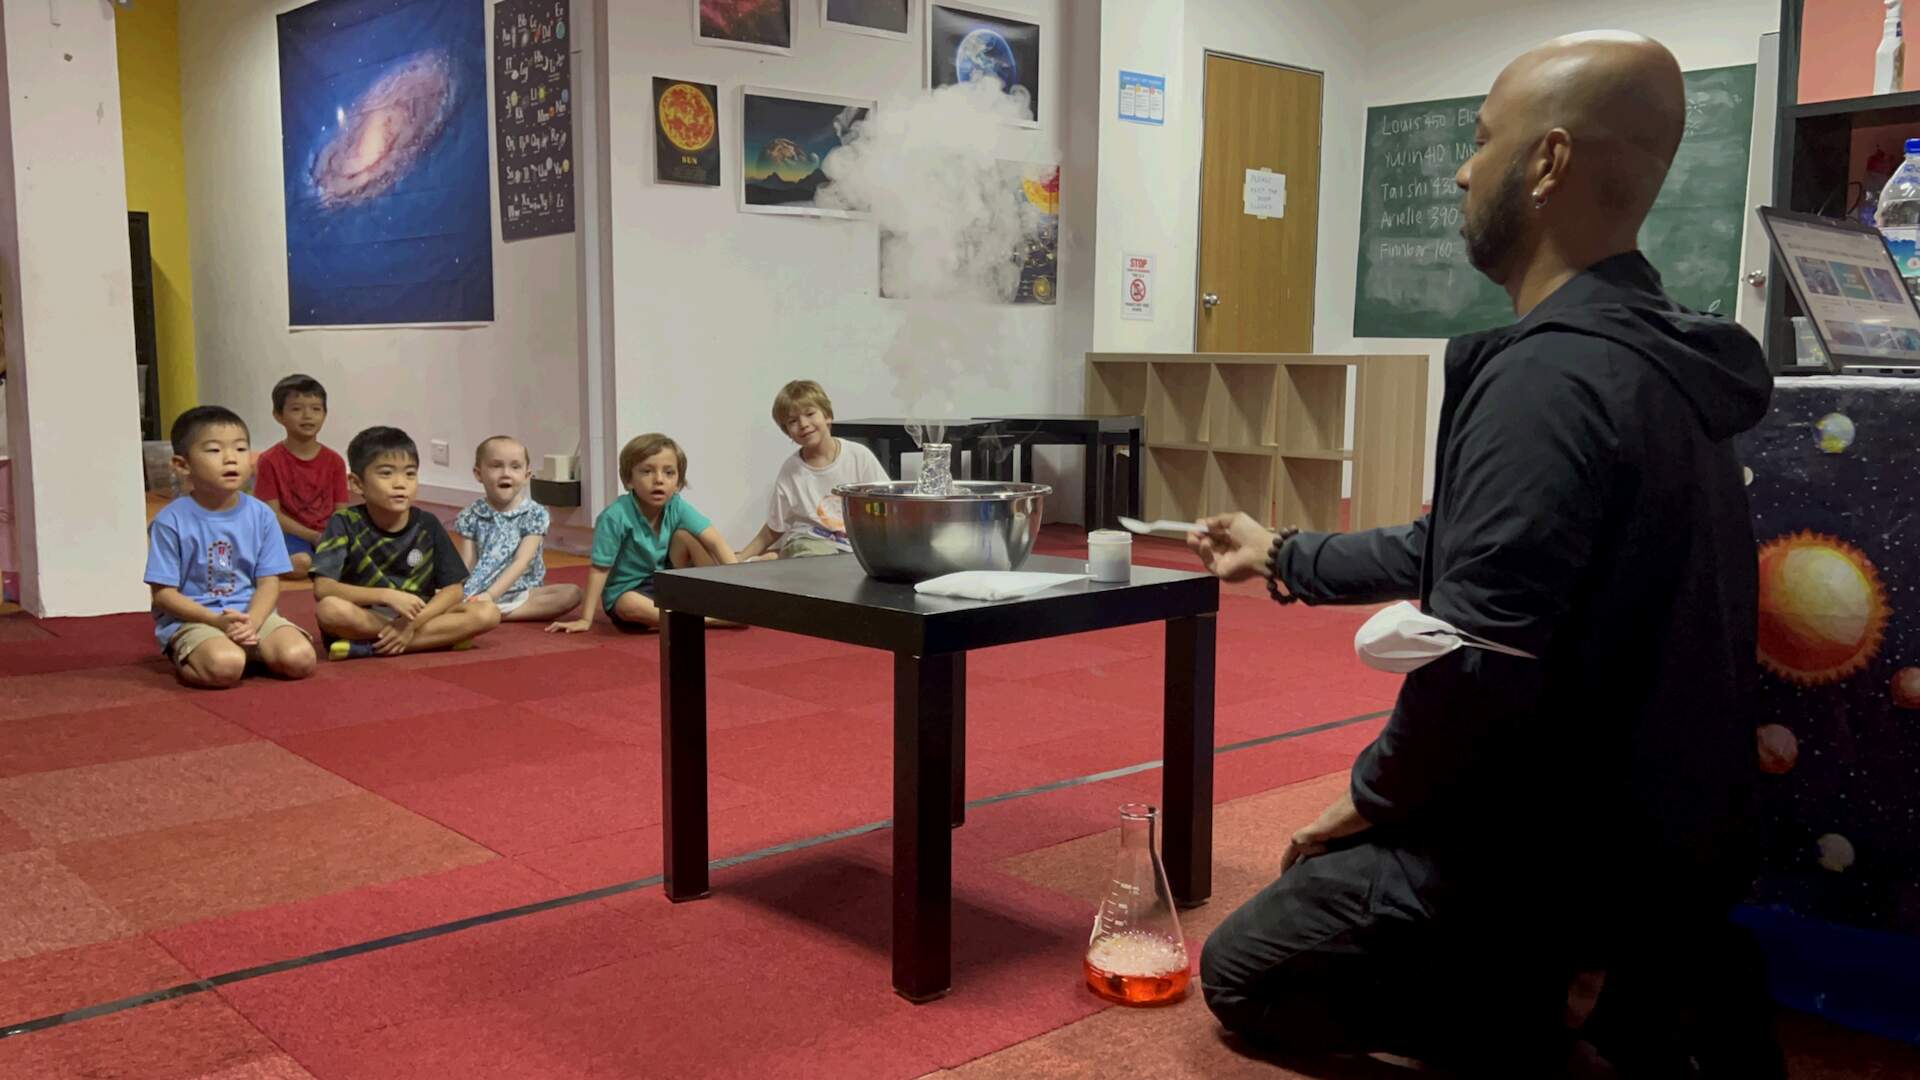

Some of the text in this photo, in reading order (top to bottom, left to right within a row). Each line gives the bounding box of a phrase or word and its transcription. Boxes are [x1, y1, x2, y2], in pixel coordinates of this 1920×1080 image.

[1382, 113, 1420, 136] Louis
[1380, 205, 1458, 230] Arielle 390
[1434, 240, 1453, 260] 160
[1129, 257, 1148, 269] STOP
